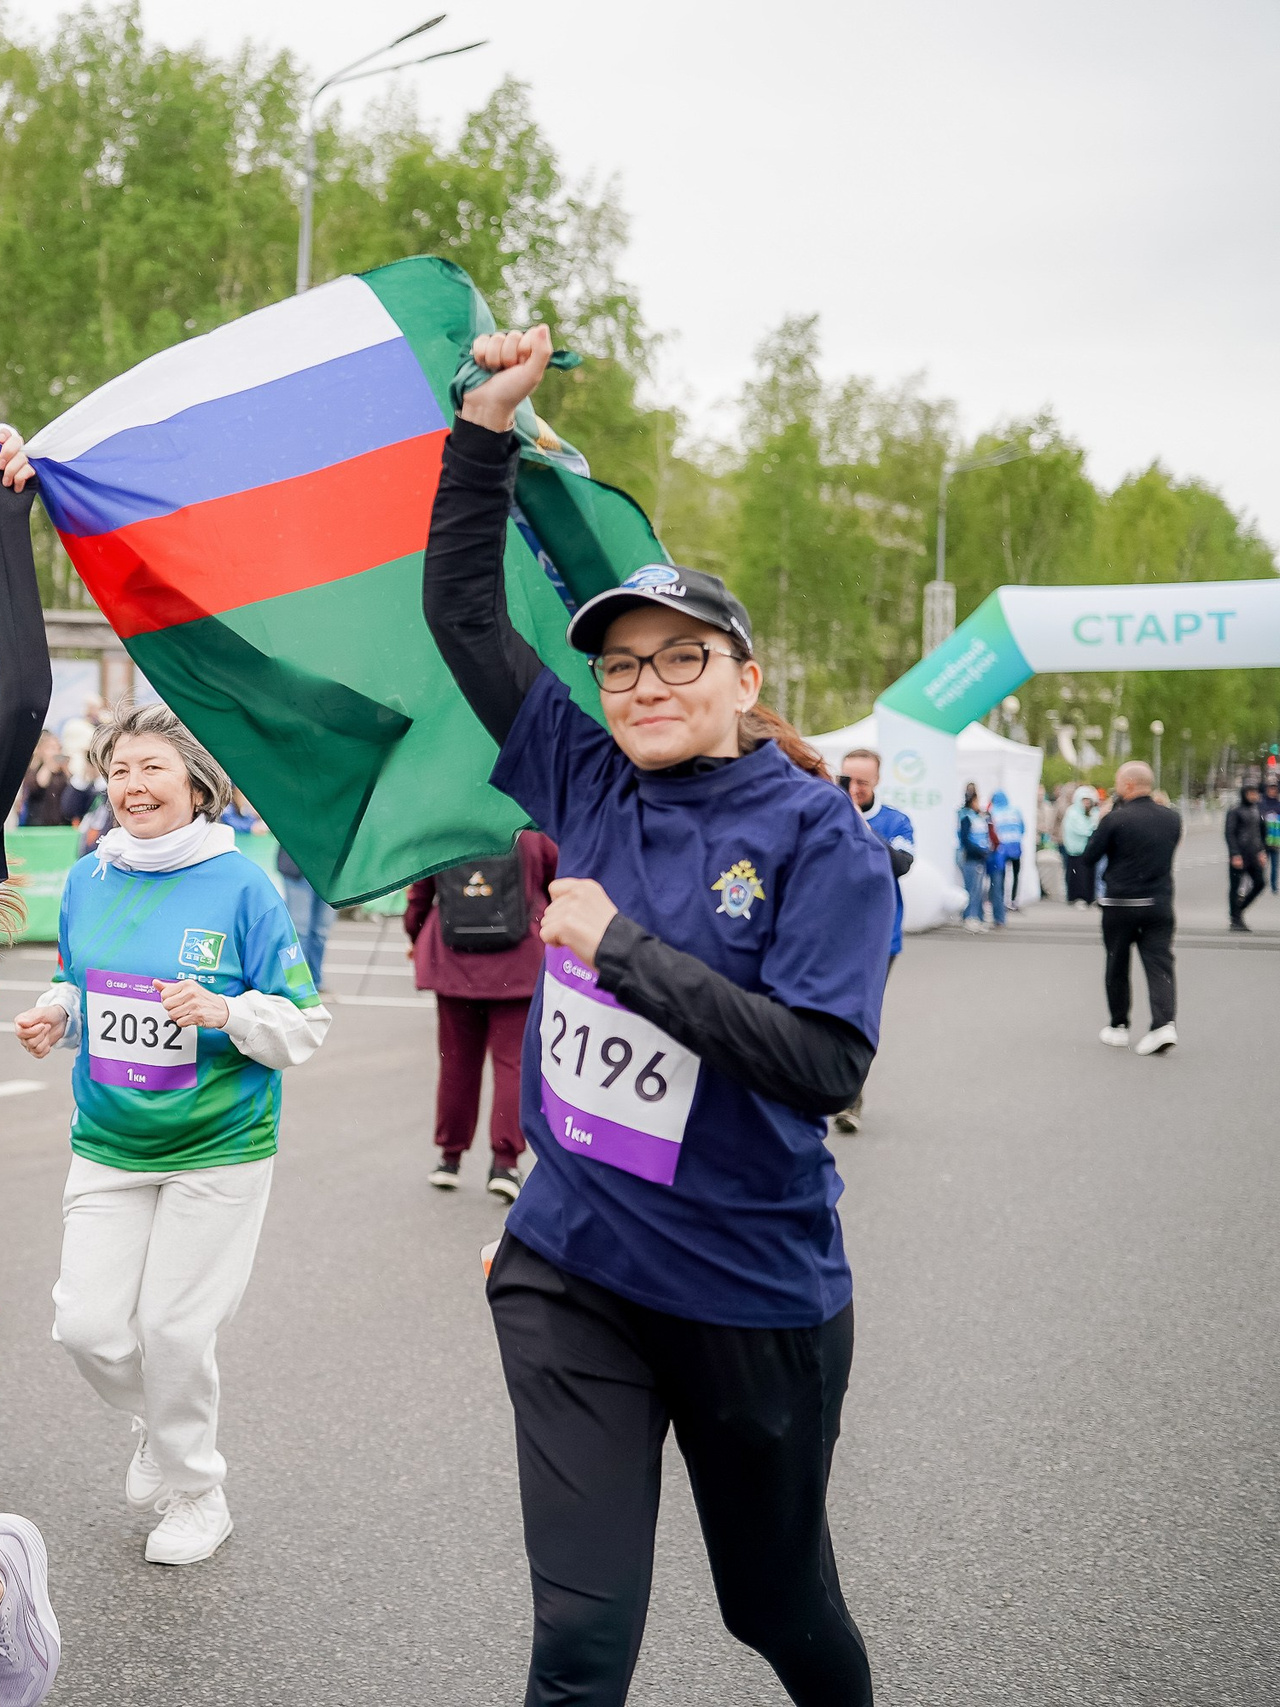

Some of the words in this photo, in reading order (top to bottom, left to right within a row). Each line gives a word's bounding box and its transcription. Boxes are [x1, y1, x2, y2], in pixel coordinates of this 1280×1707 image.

[1072, 611, 1237, 646] СТАРТ
[100, 1010, 183, 1051] 2032
[550, 1010, 667, 1103] 2196
